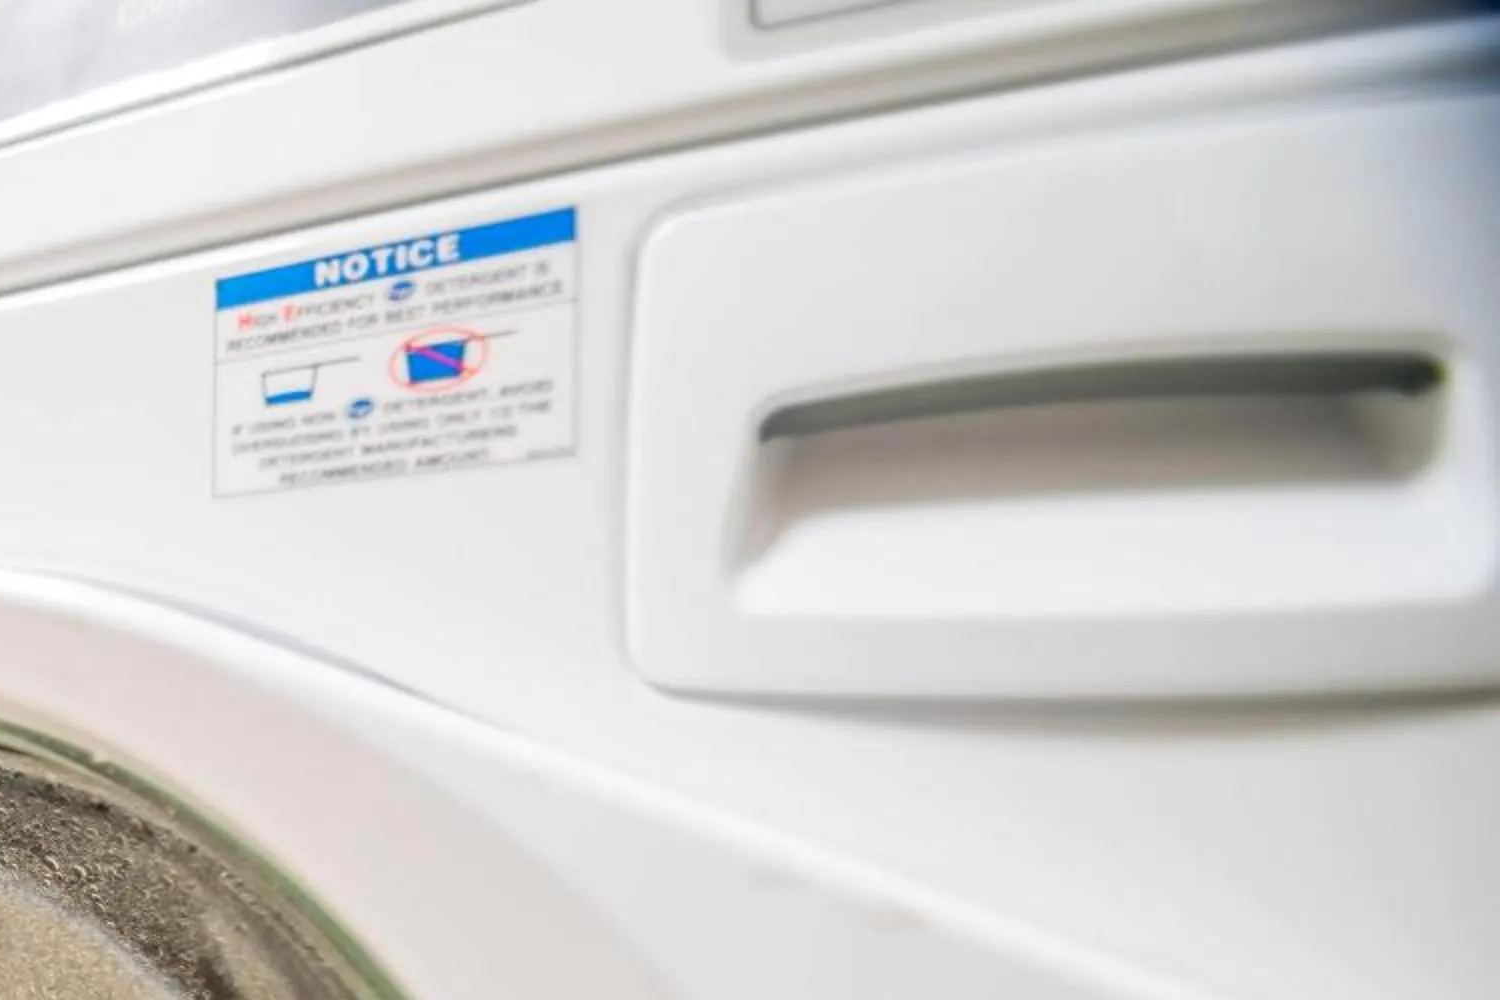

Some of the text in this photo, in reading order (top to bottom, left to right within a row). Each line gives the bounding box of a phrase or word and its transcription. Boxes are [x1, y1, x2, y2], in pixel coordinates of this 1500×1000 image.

[314, 234, 460, 287] NOTICE
[226, 320, 341, 352] RECOMMENDED
[431, 279, 563, 314] PERFORMANCE
